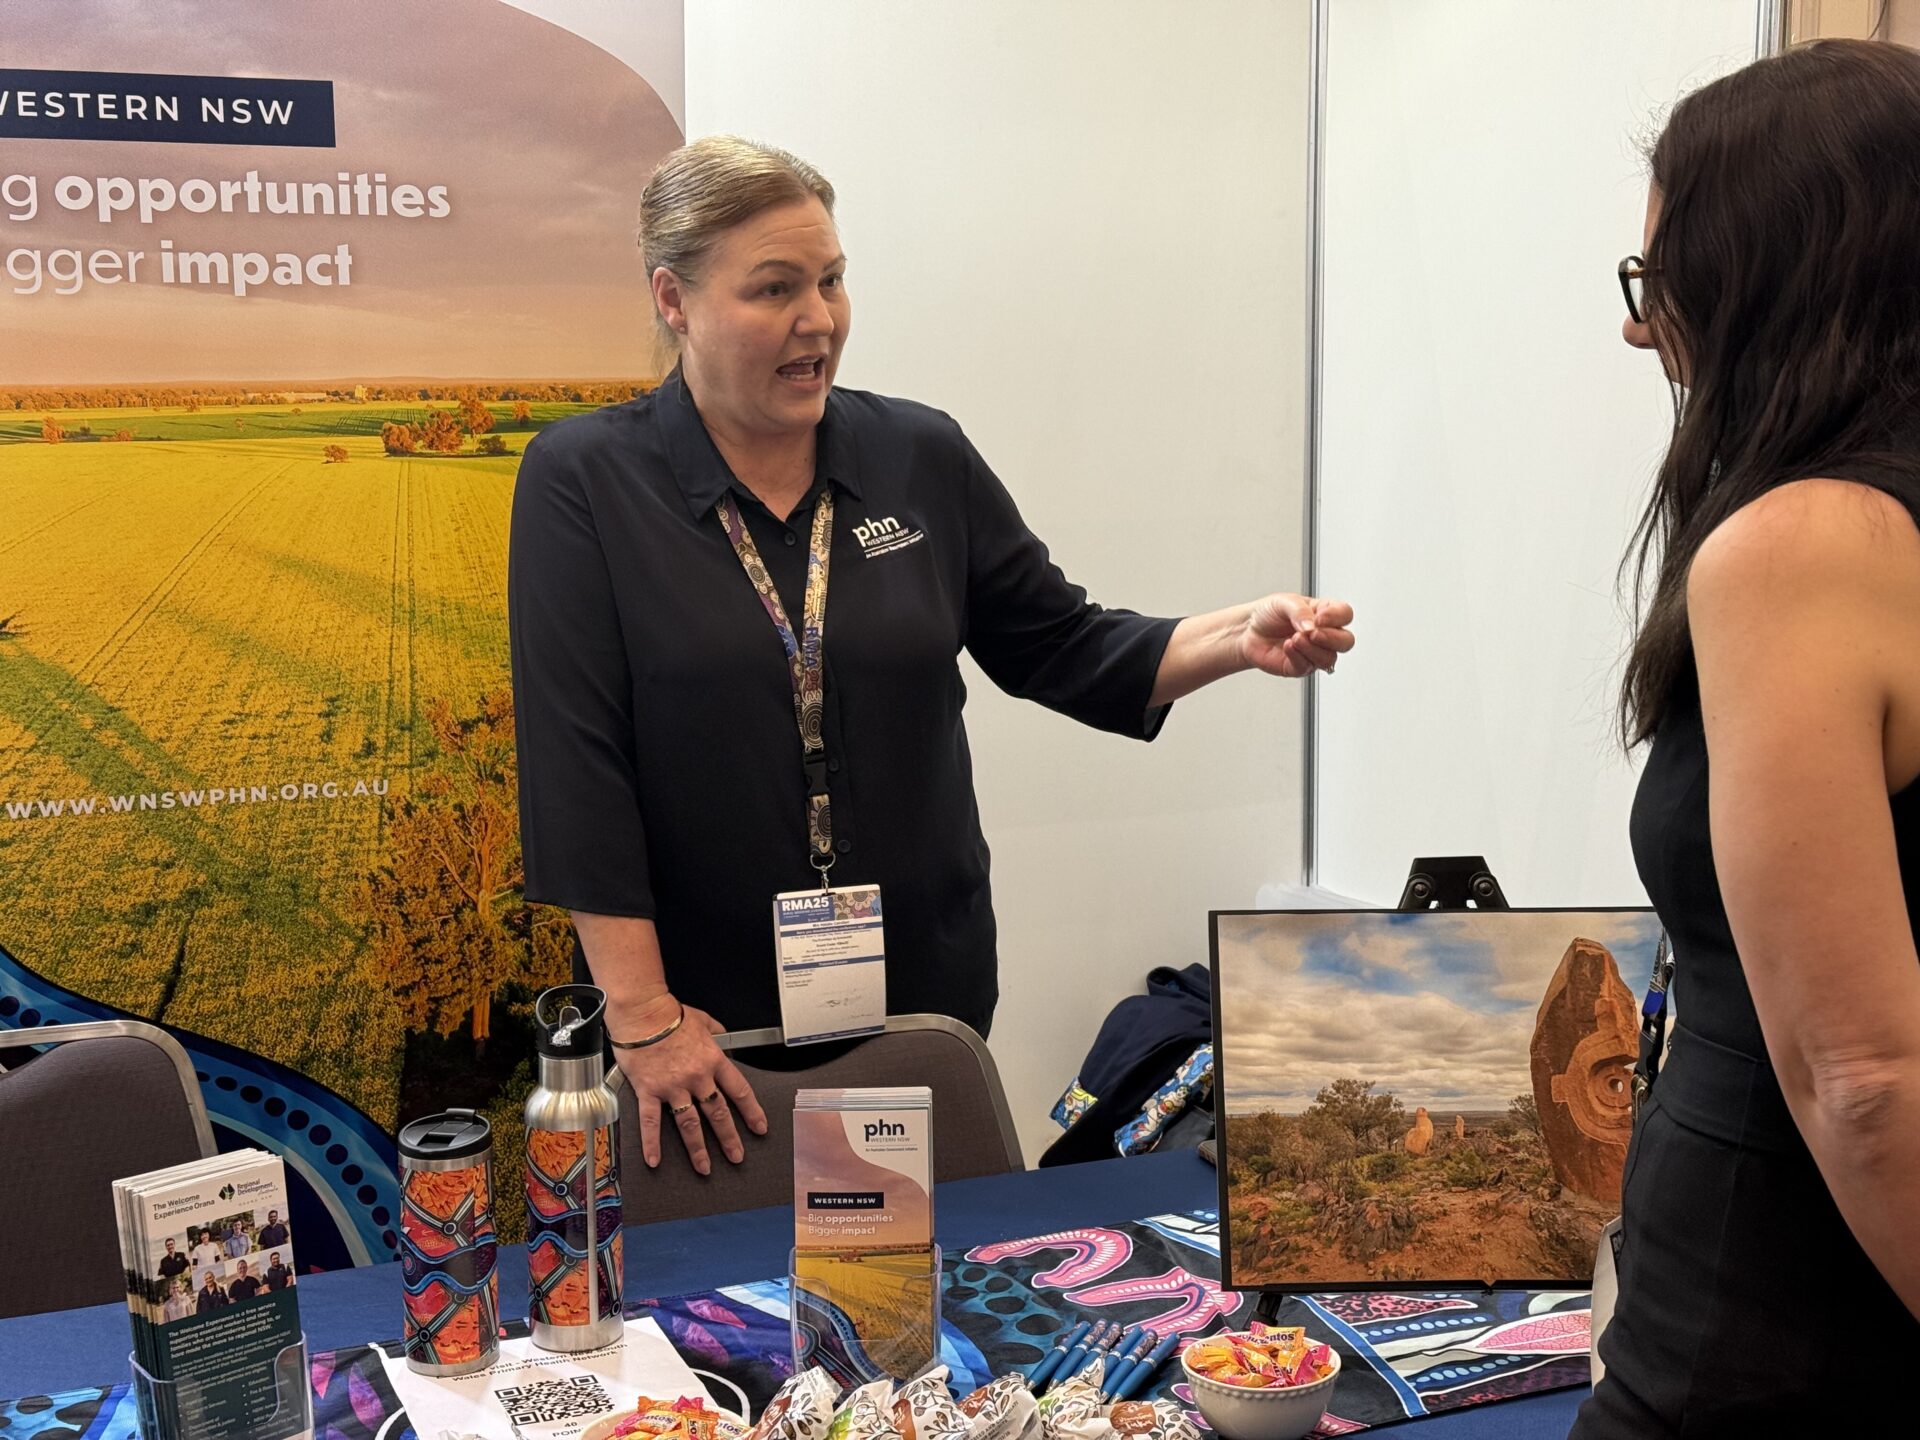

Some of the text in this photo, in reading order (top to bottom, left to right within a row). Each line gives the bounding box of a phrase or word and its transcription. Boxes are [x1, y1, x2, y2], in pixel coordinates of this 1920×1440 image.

[0, 90, 294, 125] ESTERN NSW
[54, 169, 451, 223] opportunities
[5, 239, 353, 297] gger impact
[852, 516, 900, 548] phn
[866, 533, 895, 546] WESTERN
[5, 779, 390, 819] WWW.WNSWPHN.ORG.AU
[781, 897, 830, 911] RMA25
[864, 1119, 905, 1143] phn
[237, 1179, 261, 1191] Regional
[238, 1182, 273, 1196] Development
[152, 1194, 200, 1212] The Welcome
[153, 1199, 215, 1220] Experience Orana
[808, 1213, 894, 1225] Big opportunities
[808, 1226, 876, 1237] Bigger impact
[1266, 1332, 1295, 1341] ntos
[452, 1373, 487, 1381] Wales
[489, 1364, 532, 1376] Primary
[534, 1359, 570, 1367] Health
[572, 1351, 618, 1362] Network
[490, 1362, 513, 1370] visit
[521, 1354, 567, 1364] Western
[594, 1343, 628, 1353] South
[552, 1427, 583, 1438] POIN
